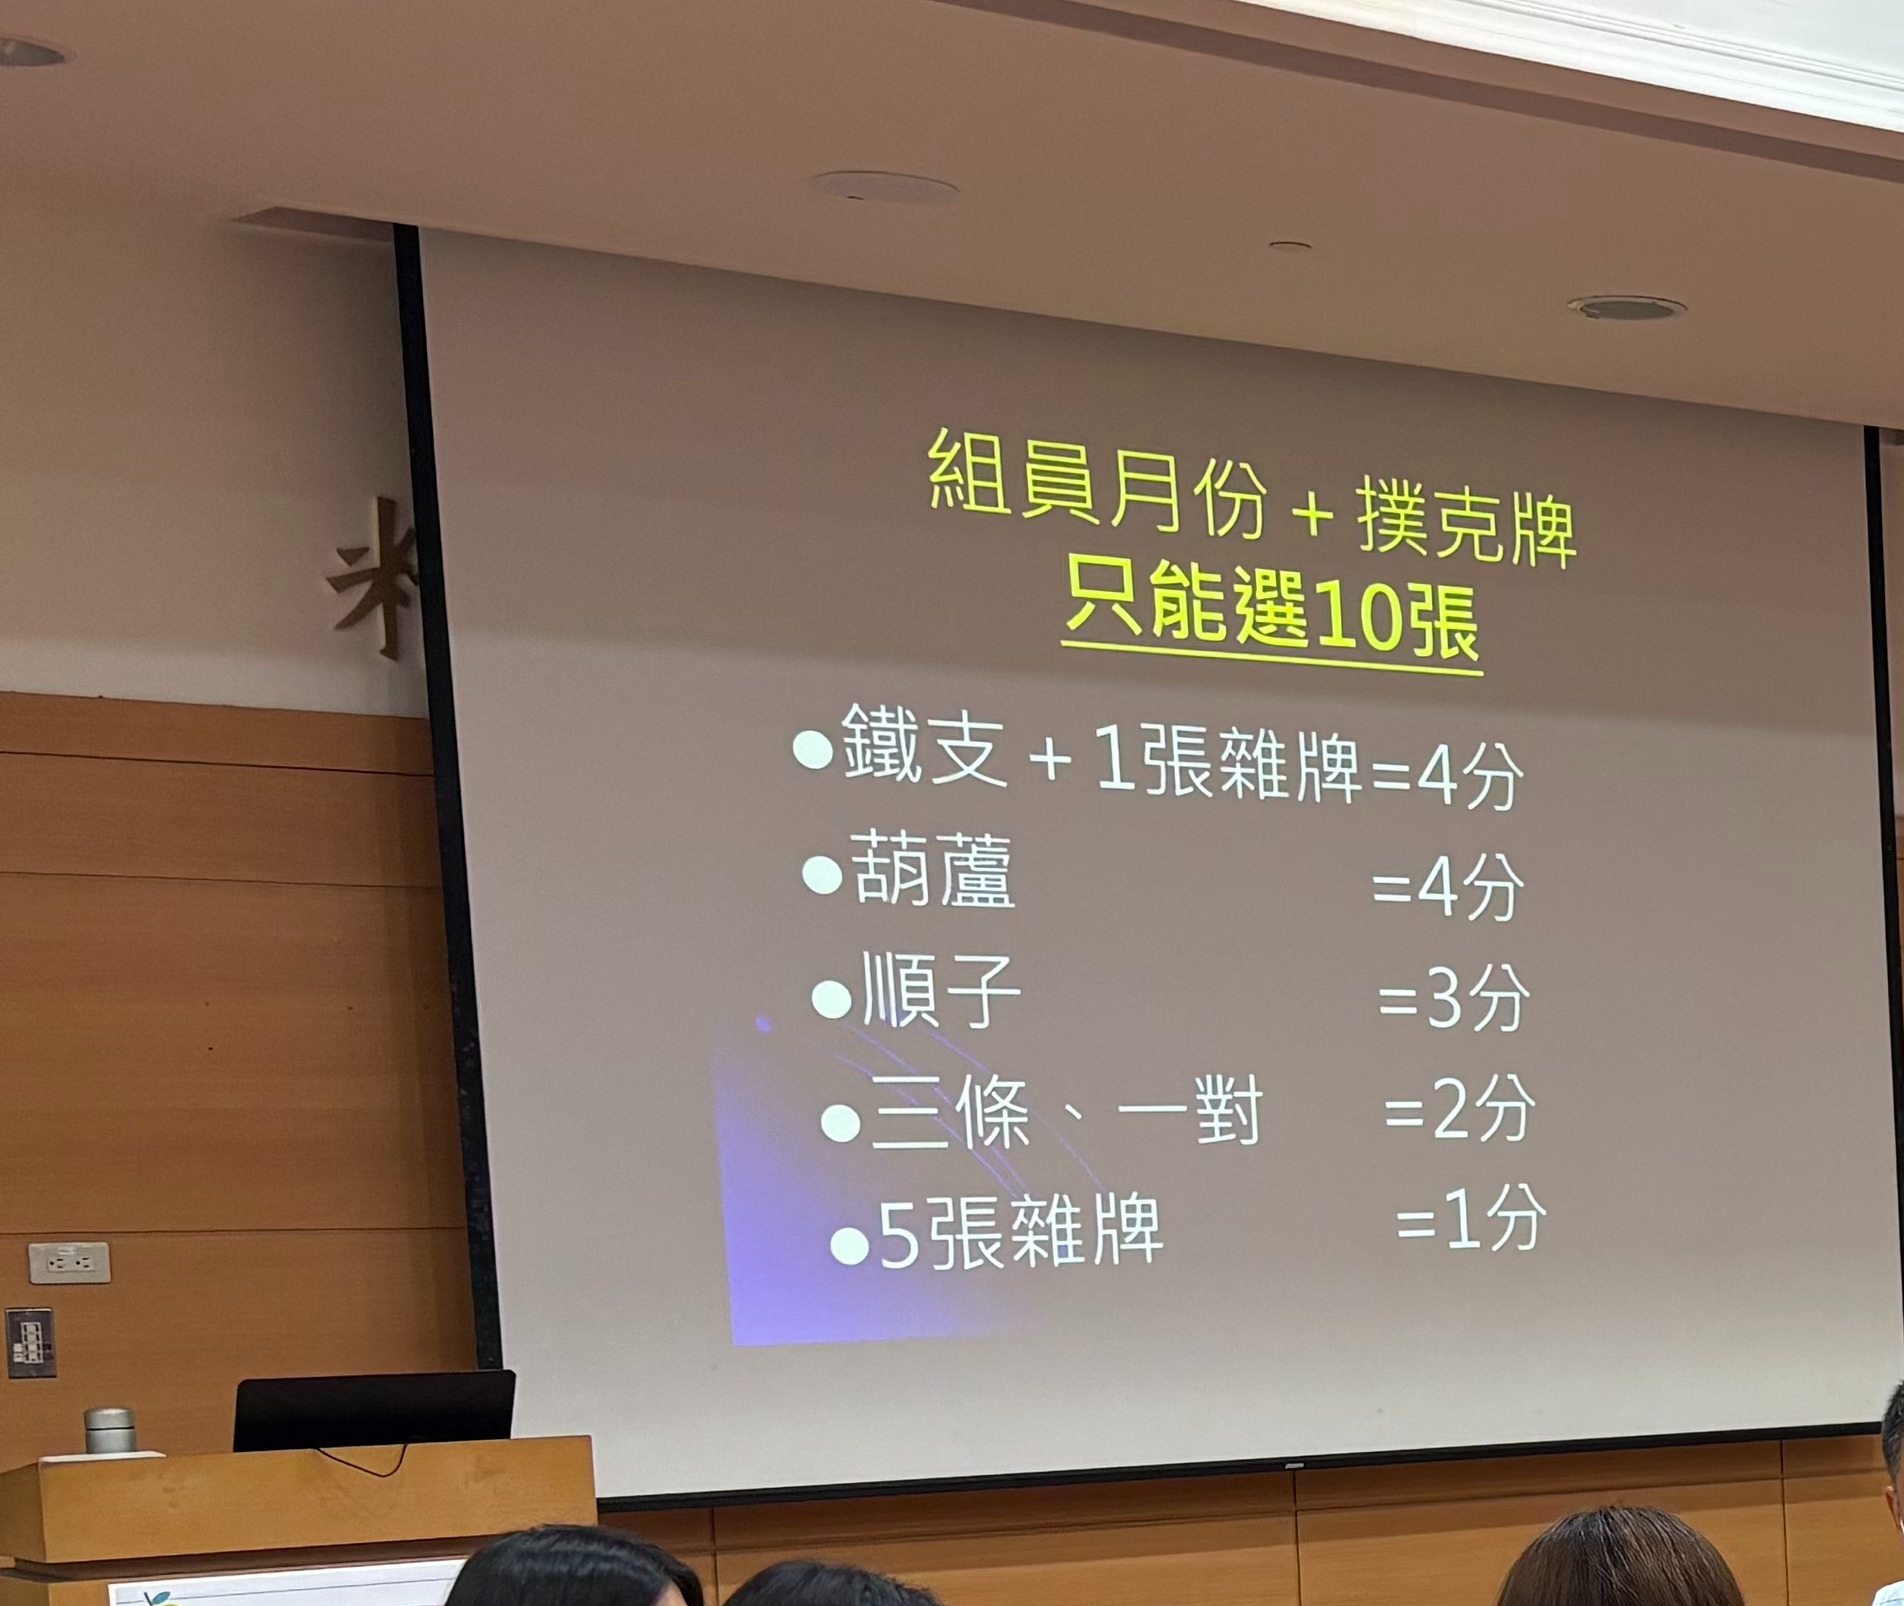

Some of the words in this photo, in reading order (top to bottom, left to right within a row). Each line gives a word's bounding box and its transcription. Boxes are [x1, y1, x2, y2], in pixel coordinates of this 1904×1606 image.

[1065, 552, 1480, 662] 只能選10張
[852, 830, 1016, 909] 葫蘆
[1372, 851, 1525, 921] =4分
[862, 953, 1021, 1029] 順子
[1378, 963, 1531, 1032] =3分
[1384, 1072, 1536, 1143] =2分
[878, 1192, 1165, 1270] 5張雜牌
[1397, 1182, 1548, 1252] =1分
